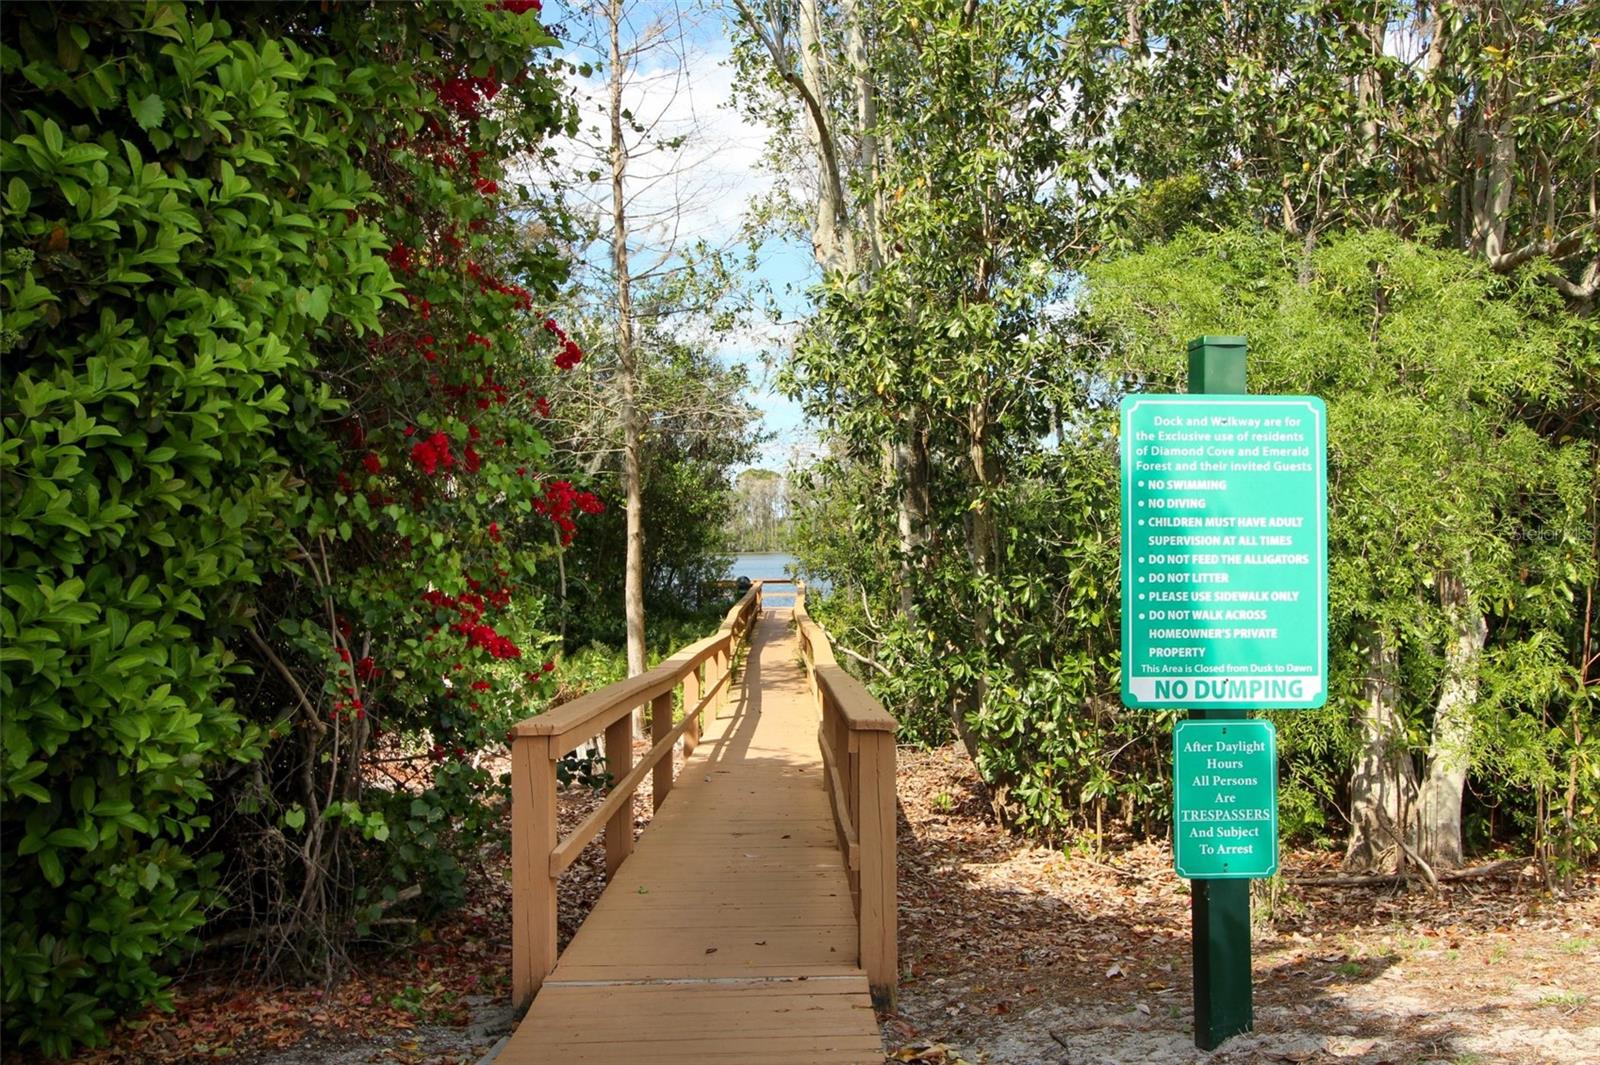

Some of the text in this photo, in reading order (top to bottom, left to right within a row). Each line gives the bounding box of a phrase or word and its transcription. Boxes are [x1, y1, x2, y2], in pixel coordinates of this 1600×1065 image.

[1154, 417, 1301, 429] Dock and Walkway are for
[1136, 432, 1154, 441] the
[1158, 432, 1211, 441] Exclusive
[1237, 432, 1249, 441] of
[1252, 432, 1304, 441] residents
[1136, 447, 1309, 456] of Diamond Cove and Emerald
[1136, 462, 1312, 471] Forest and their invited Guests
[1148, 480, 1227, 490] NO SWIMMING
[1148, 499, 1206, 508] NO DIVING
[1148, 518, 1303, 527] CHILDREN MUST HAVE ADULT
[1148, 536, 1292, 546] SUPERVISION AT ALL TIMES
[1148, 555, 1309, 565] DO NOT FEED THE ALLIGATORS
[1148, 573, 1228, 583] DO NOT LITTER
[1149, 592, 1299, 601] PLEASE USE SIDEWALK ONLY
[1148, 611, 1267, 620] DO NOT WALK ACROSS
[1234, 629, 1277, 638] PRIVATE
[1149, 648, 1205, 657] PROPERTY
[1141, 664, 1312, 673] This Area is Closed from Dusk to Dawn
[1155, 680, 1303, 699] NO DUMPING
[1184, 742, 1264, 754] After Daylight
[1207, 759, 1243, 769] Hours
[1192, 776, 1257, 786] All Persons
[1215, 793, 1236, 803] Are
[1181, 810, 1270, 821] TRESPASSERS
[1189, 827, 1259, 839] And Subject
[1200, 845, 1253, 854] To Arrest
